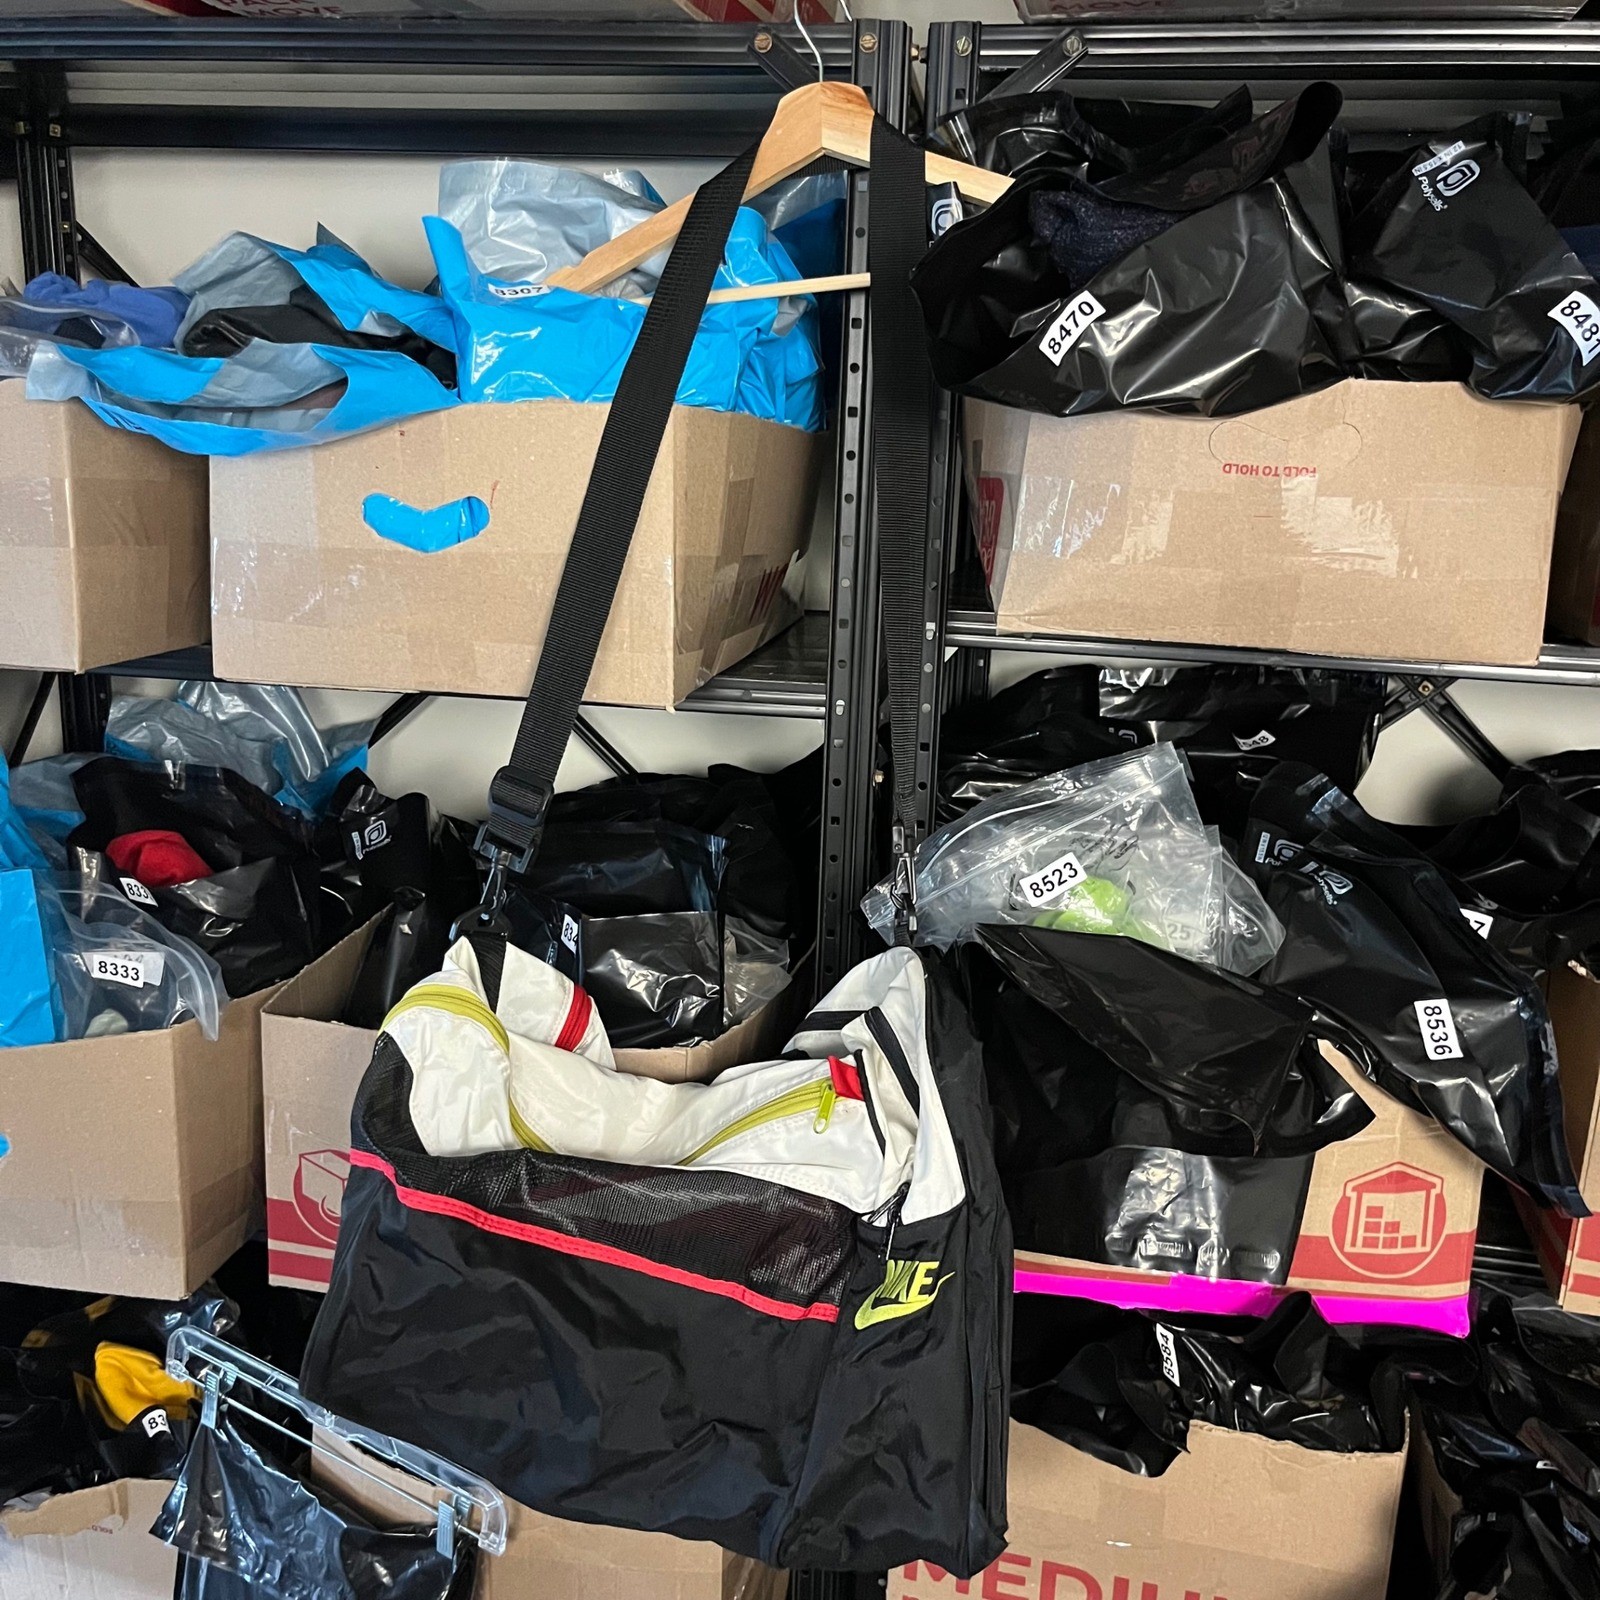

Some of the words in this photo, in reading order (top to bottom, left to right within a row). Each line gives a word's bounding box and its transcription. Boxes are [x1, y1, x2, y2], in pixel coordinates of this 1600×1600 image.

[1047, 300, 1095, 355] 8470
[1559, 299, 1600, 355] 8481
[1222, 463, 1260, 476] HOLD
[1262, 465, 1280, 477] TO
[1029, 861, 1079, 898] 8523
[97, 960, 140, 982] 8333
[1423, 1005, 1453, 1056] 8536
[1159, 1331, 1175, 1379] 8584
